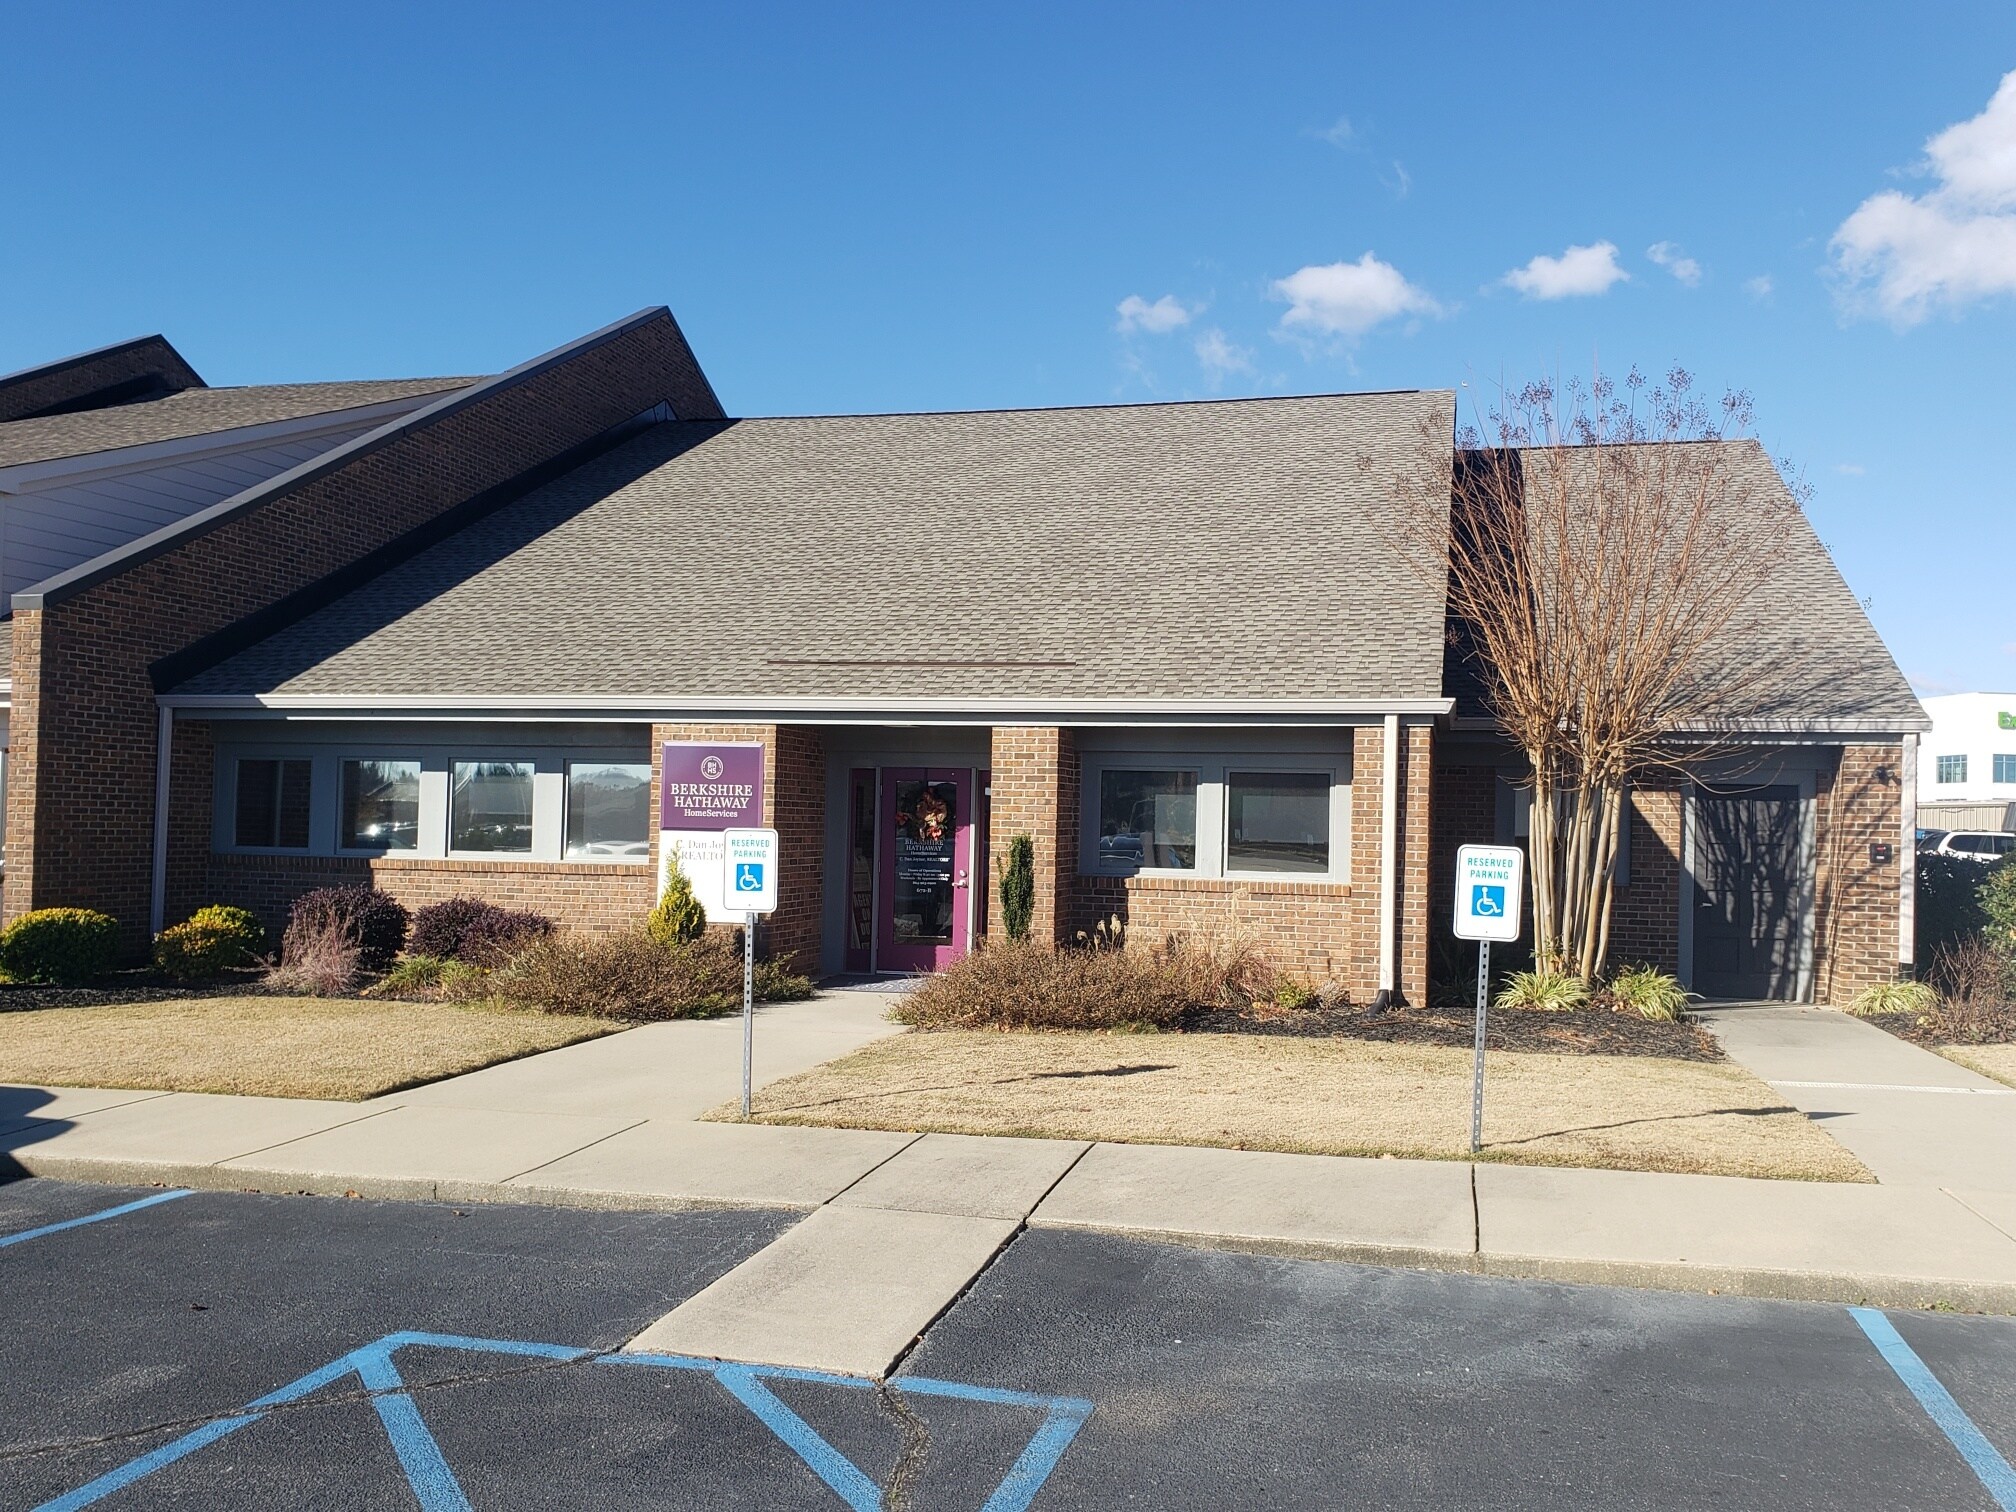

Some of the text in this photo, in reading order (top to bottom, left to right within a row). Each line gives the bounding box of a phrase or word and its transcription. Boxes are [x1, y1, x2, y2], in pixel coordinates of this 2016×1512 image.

[670, 783, 753, 796] BERKSHIRE
[674, 796, 750, 809] HATHAWAY
[684, 809, 738, 818] HomeServices
[688, 839, 707, 849] Dan
[731, 839, 770, 848] RESERVED
[733, 850, 767, 858] PARKING
[1467, 857, 1514, 868] RESERVED
[1470, 869, 1509, 880] PARKING
